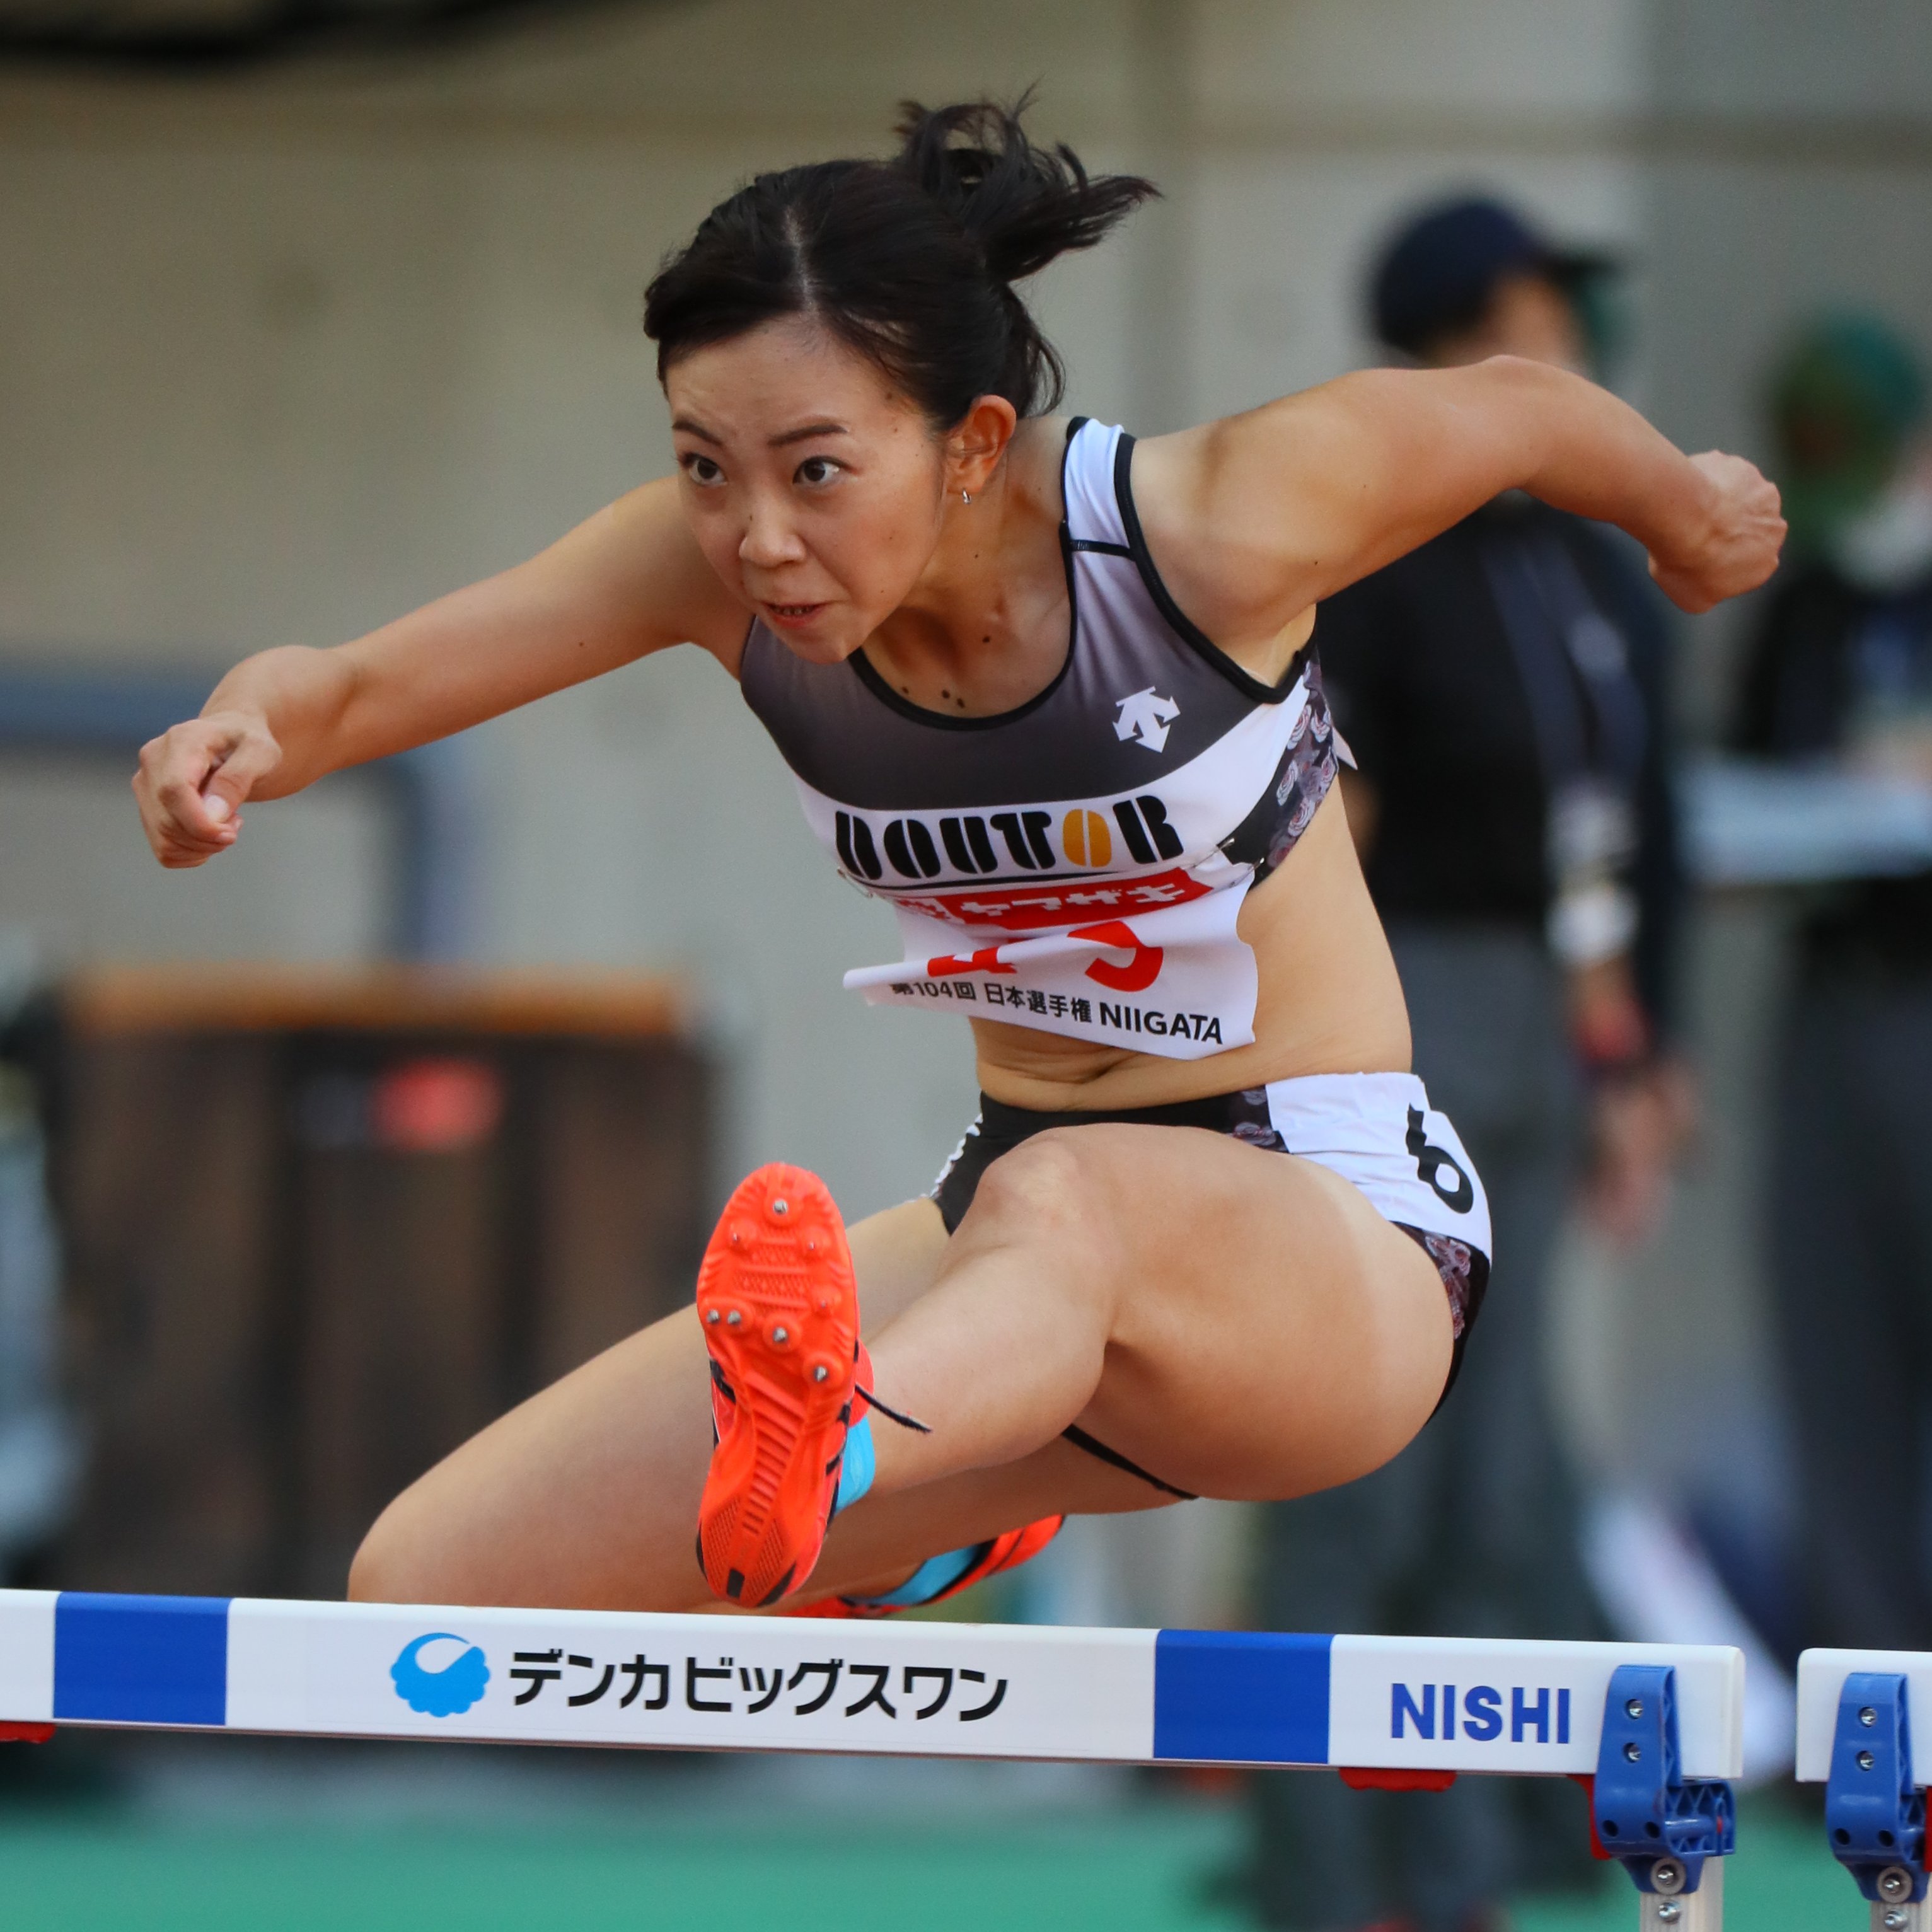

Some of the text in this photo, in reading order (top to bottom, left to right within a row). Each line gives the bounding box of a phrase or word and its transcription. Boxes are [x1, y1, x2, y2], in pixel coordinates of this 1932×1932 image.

[835, 795, 1184, 880] DOUTOR
[984, 982, 1092, 1024] 日本選手権
[1099, 1002, 1223, 1045] NIIGATA
[510, 1649, 1008, 1721] デンカビッグスワン
[1391, 1683, 1570, 1744] NISHI
